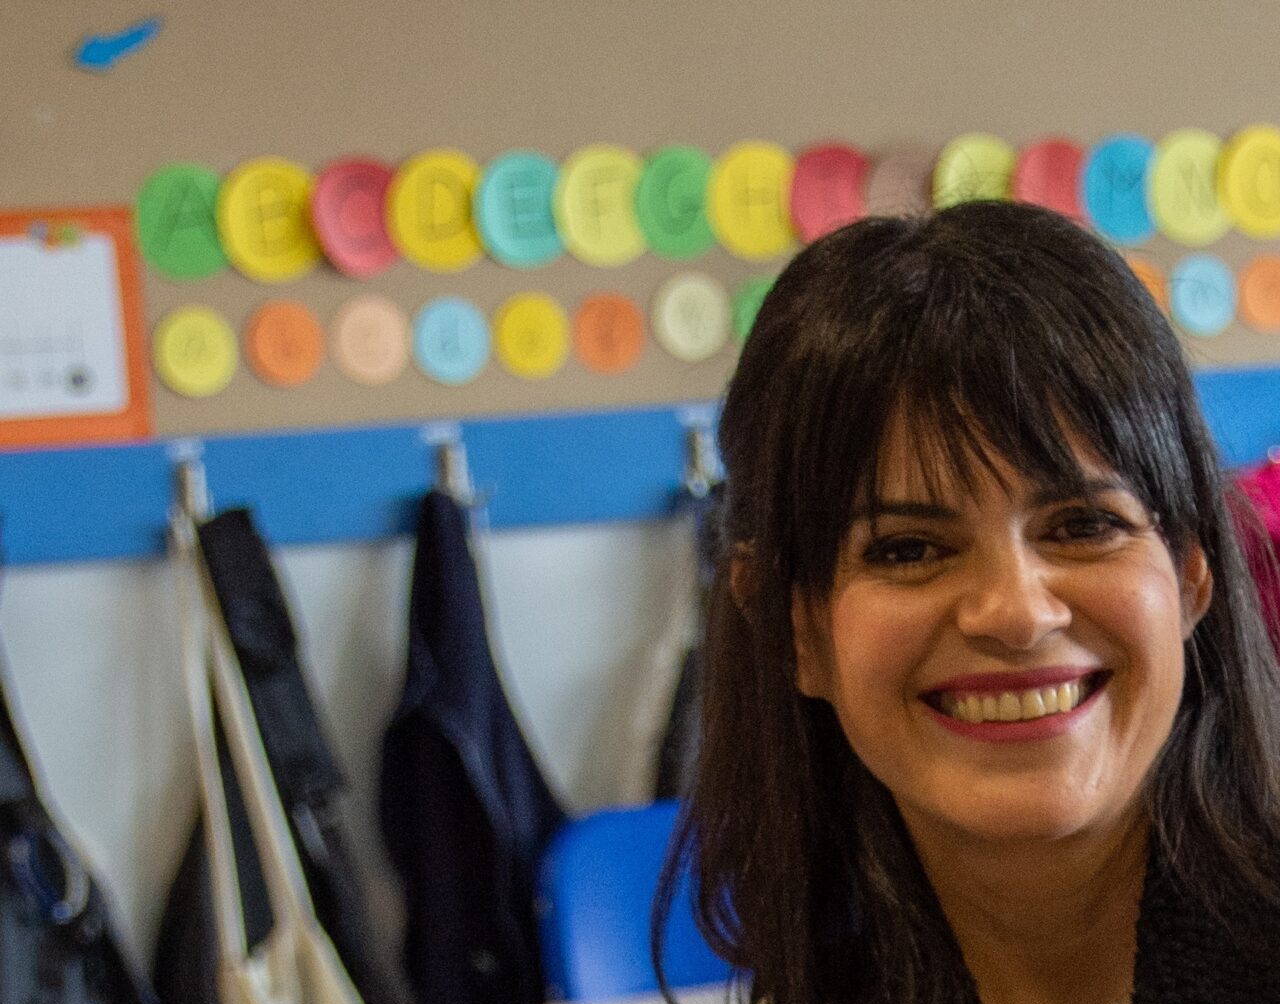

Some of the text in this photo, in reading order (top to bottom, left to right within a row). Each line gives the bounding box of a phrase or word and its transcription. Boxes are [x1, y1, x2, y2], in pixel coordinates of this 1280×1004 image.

[158, 179, 220, 250] A
[257, 178, 297, 250] B
[420, 168, 462, 240] D
[508, 170, 554, 238] E
[588, 168, 622, 238] F
[650, 163, 702, 236] G
[732, 168, 778, 232] H
